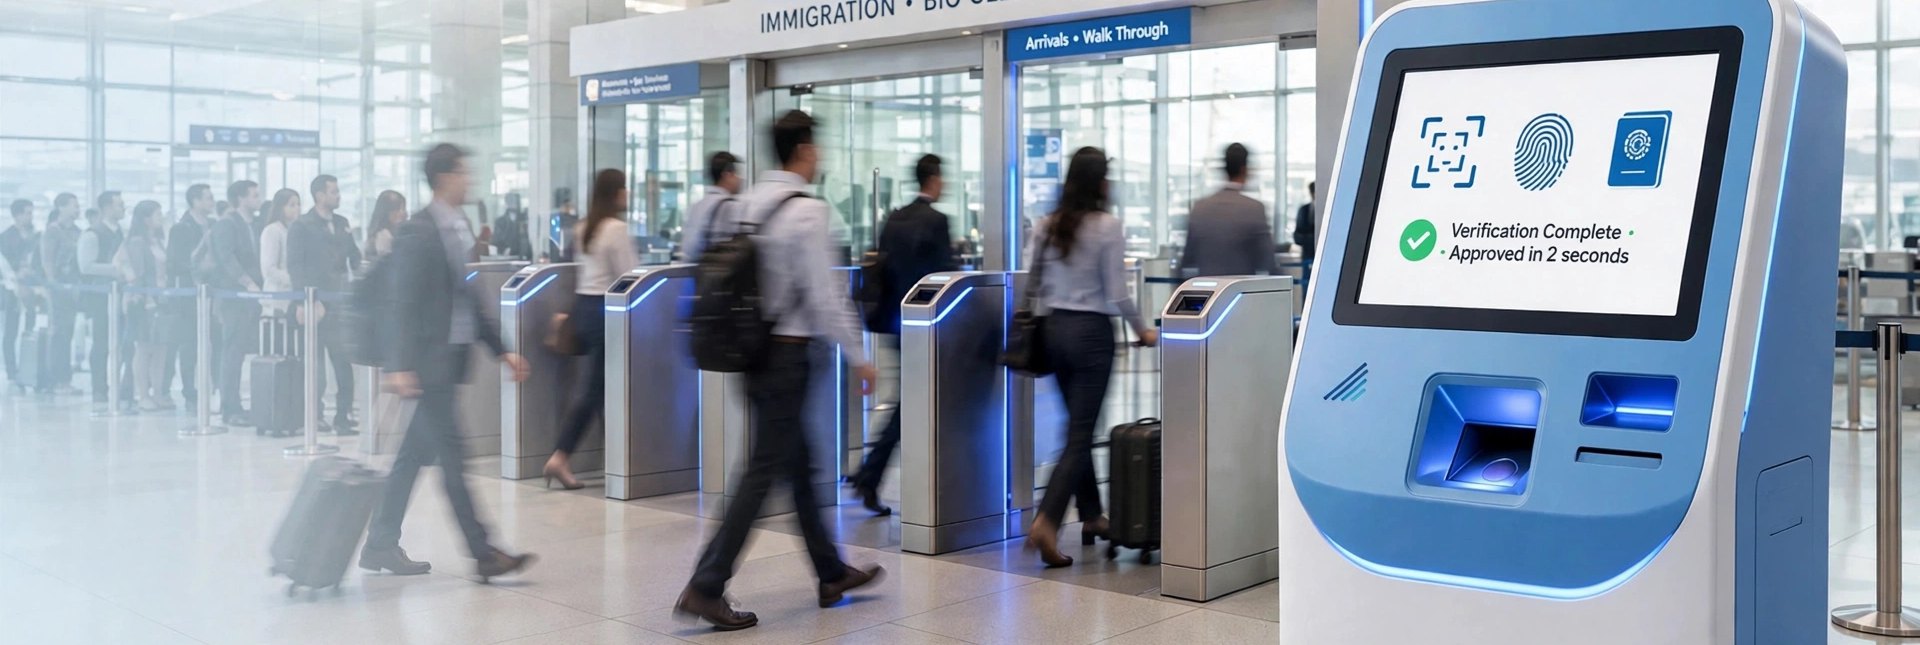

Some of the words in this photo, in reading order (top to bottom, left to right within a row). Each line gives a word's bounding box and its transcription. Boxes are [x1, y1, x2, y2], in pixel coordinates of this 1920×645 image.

[761, 0, 895, 33] IMMIGRATION
[1025, 31, 1069, 50] Arrivals
[1082, 26, 1113, 44] Walk
[1115, 20, 1169, 41] Through
[1452, 222, 1539, 239] Verification
[1543, 223, 1622, 243] Complete
[1449, 245, 1525, 264] Approved
[1528, 246, 1543, 262] in
[1546, 246, 1558, 262] 2
[1561, 247, 1629, 264] seconds
